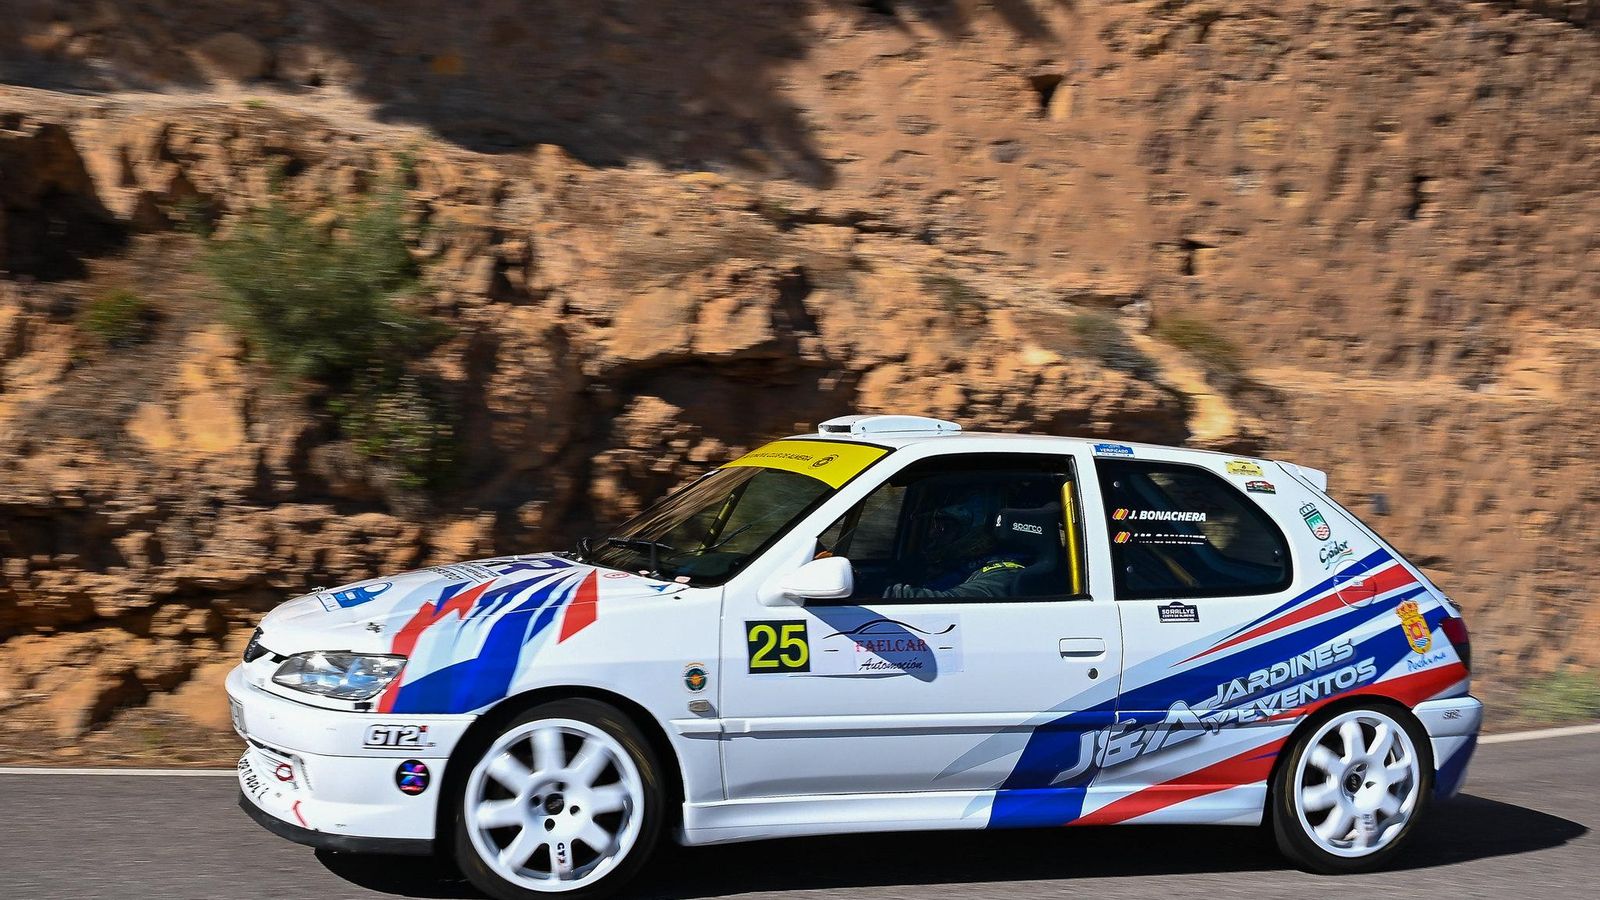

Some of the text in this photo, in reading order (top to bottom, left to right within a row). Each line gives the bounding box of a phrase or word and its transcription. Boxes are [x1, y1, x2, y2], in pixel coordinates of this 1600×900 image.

[1129, 509, 1207, 521] J. BONACHERA
[1012, 522, 1043, 533] sparco
[748, 624, 809, 668] 25
[854, 639, 928, 653] FAELCAR
[858, 657, 923, 671] Automoción
[1207, 640, 1355, 707] JARDINES
[1238, 656, 1378, 723] EVENTOS
[363, 723, 429, 747] GT2i
